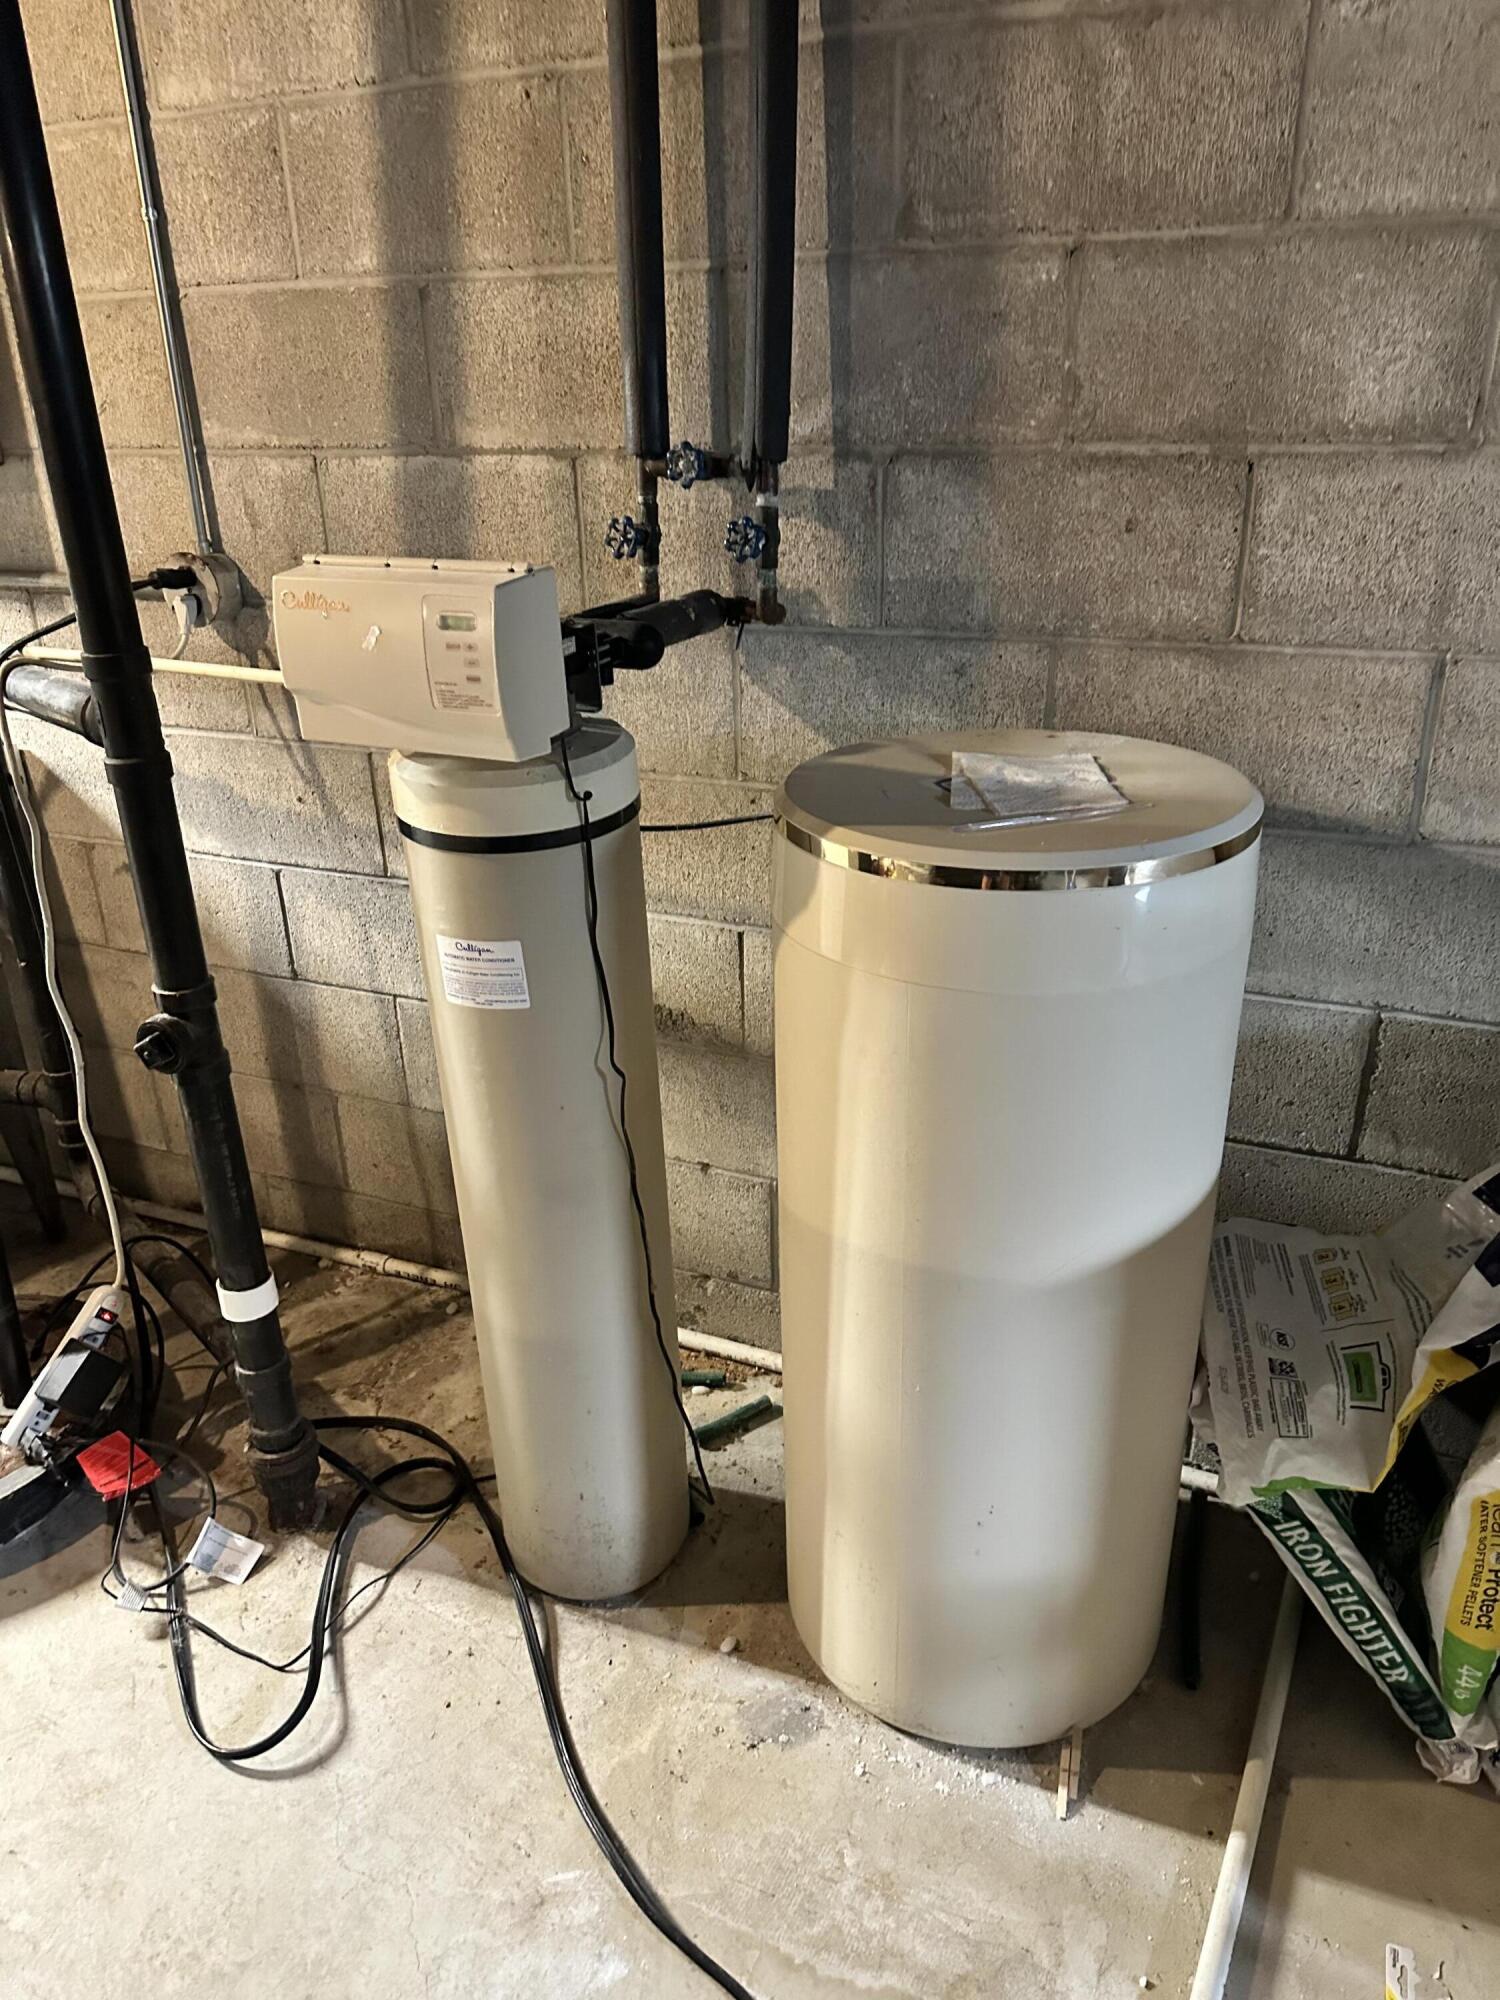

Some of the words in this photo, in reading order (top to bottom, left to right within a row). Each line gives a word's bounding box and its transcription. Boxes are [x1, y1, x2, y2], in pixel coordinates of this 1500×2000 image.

[281, 589, 350, 620] Culligan
[455, 942, 495, 957] Culligan
[1471, 1535, 1487, 1588] SOFTENER
[1274, 1520, 1339, 1578] IRON
[1324, 1582, 1409, 1683] FIGHTER
[1460, 1588, 1479, 1626] PELLETS
[1475, 1568, 1500, 1631] Protect
